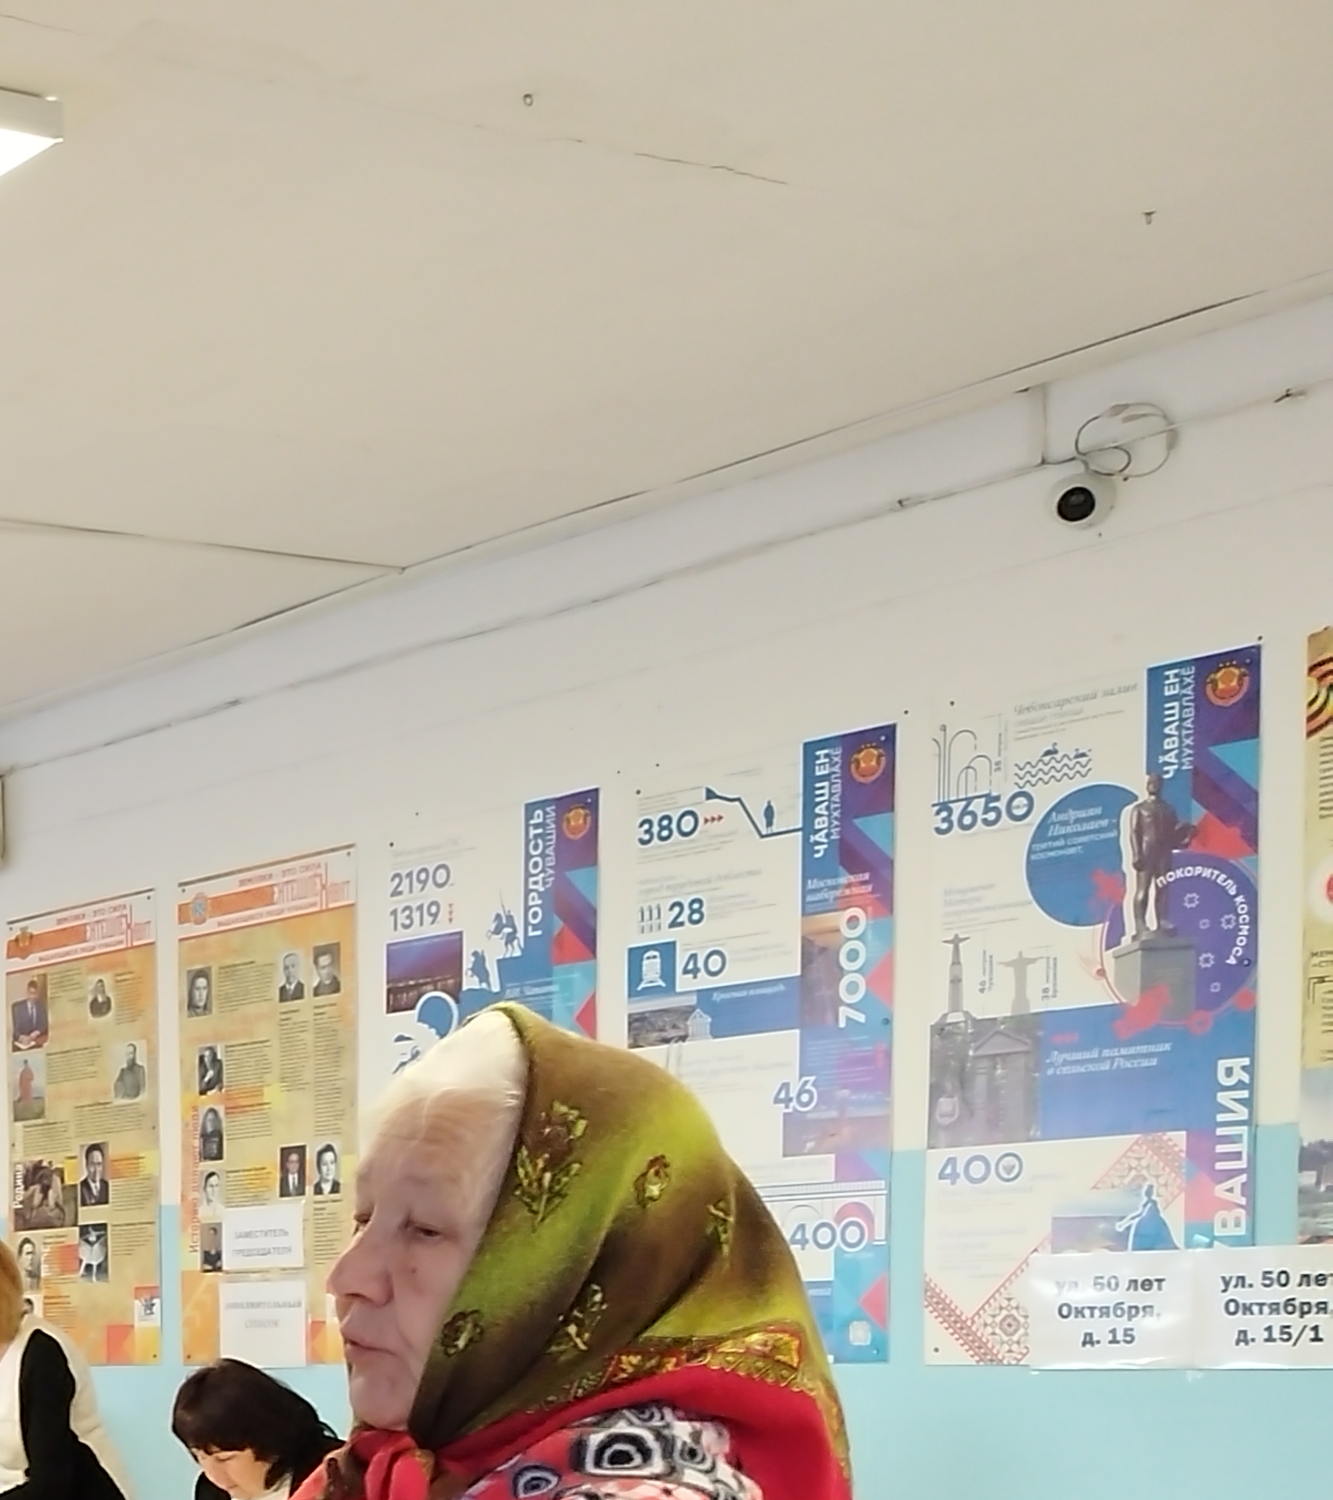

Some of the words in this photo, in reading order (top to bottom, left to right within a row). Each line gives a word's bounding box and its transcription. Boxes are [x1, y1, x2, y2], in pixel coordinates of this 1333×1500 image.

[1165, 668, 1179, 694] ЕН
[816, 748, 831, 778] ЕН
[637, 808, 700, 846] 380
[933, 790, 1035, 836] 3650
[546, 805, 556, 888] ЧУВАШИИ
[390, 862, 451, 898] 2190
[528, 807, 543, 937] ГОРДОСТЬ
[390, 900, 441, 931] 1319
[667, 898, 706, 928] 28
[1156, 866, 1238, 896] ПОКОРИТЕЛЬ
[1225, 895, 1250, 965] КОСМОСА
[682, 949, 727, 979] 40
[838, 907, 868, 1028] 7000
[1046, 1047, 1099, 1065] Лучший
[1101, 1043, 1172, 1058] памятник
[1056, 1060, 1110, 1075] сельской
[1113, 1057, 1157, 1070] России
[773, 1077, 817, 1111] 46
[937, 1152, 1024, 1186] 400
[1214, 1057, 1251, 1248] ВАШИЯ
[13, 1163, 24, 1210] Родина
[790, 1218, 867, 1251] 400
[1092, 1274, 1120, 1293] 50
[1126, 1276, 1165, 1293] лет
[1220, 1275, 1254, 1293] ул.
[1261, 1270, 1290, 1288] 50
[1082, 1331, 1101, 1347] д.
[1108, 1327, 1136, 1345] 15
[1235, 1329, 1256, 1346] д.
[1263, 1324, 1324, 1347] 15/1
